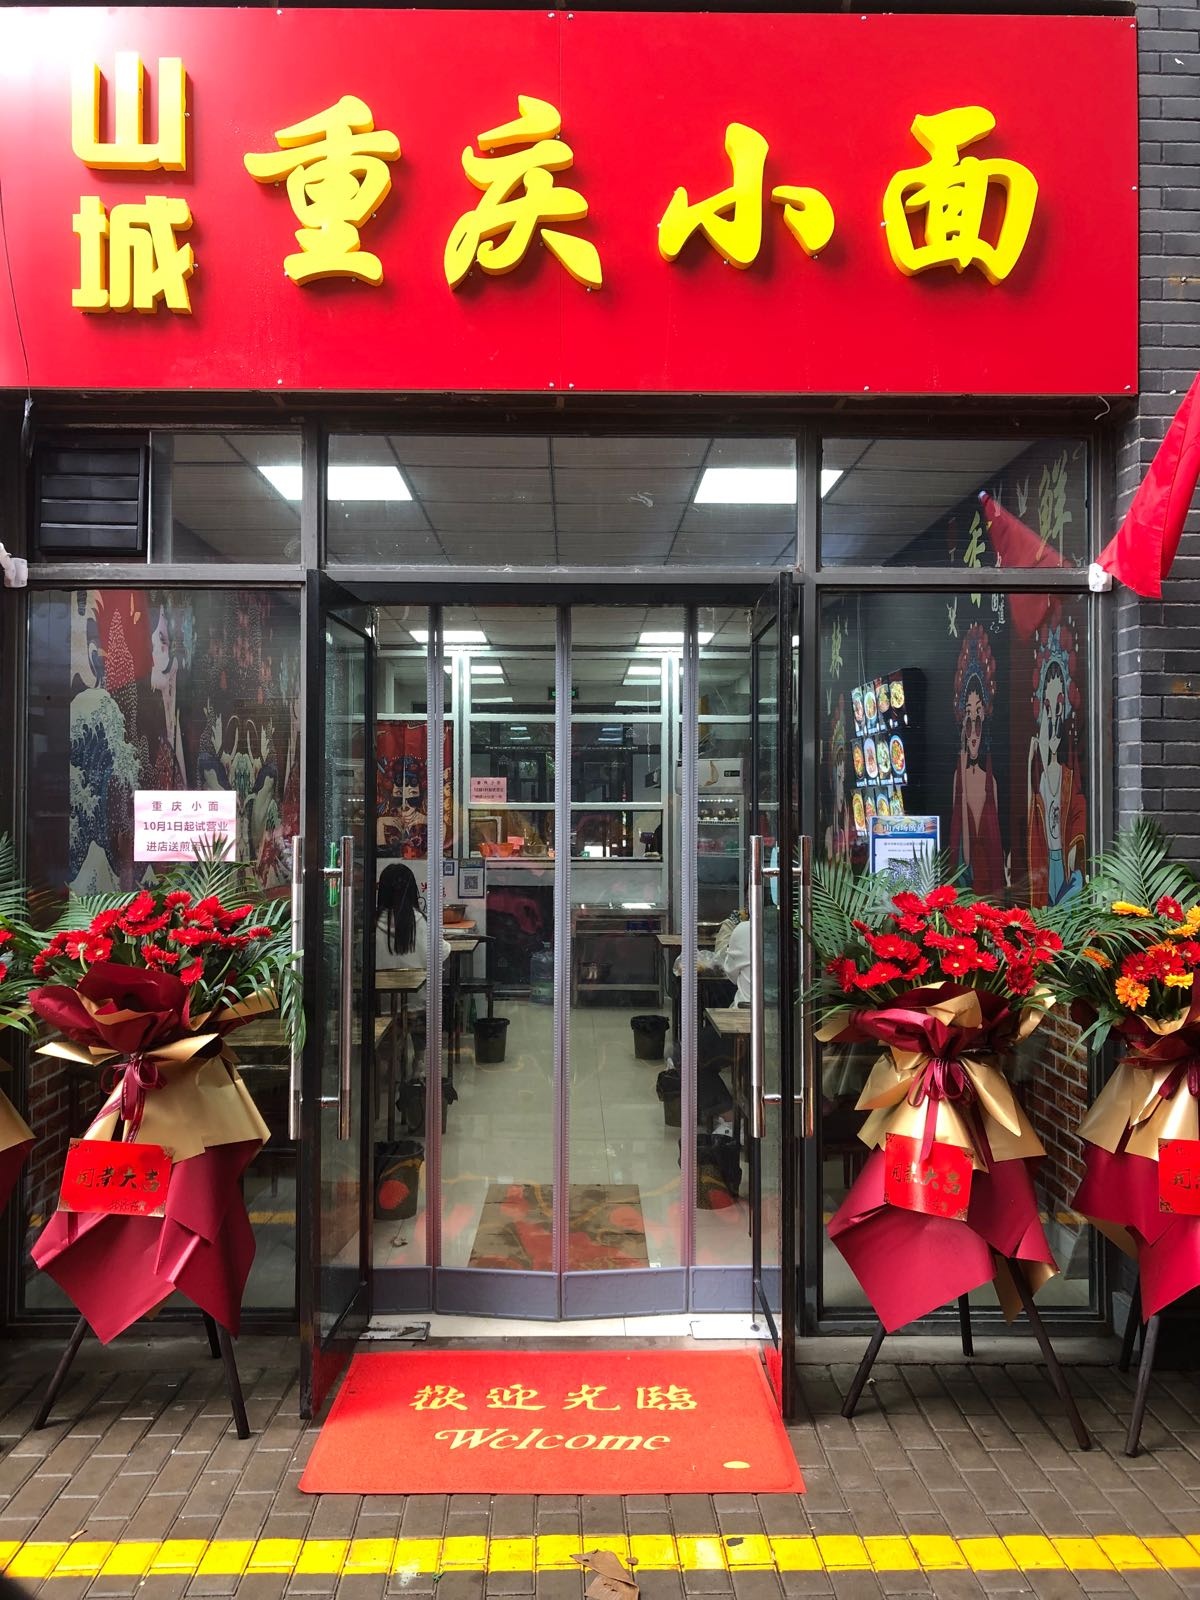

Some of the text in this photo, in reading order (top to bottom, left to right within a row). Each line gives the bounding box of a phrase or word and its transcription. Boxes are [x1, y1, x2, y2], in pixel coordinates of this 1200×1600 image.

[71, 50, 194, 314] 山城
[243, 94, 1040, 288] 重庆小面
[152, 801, 219, 812] 重庆小面
[143, 821, 229, 832] 10月1日起试营业
[434, 1428, 671, 1450] Welcome
